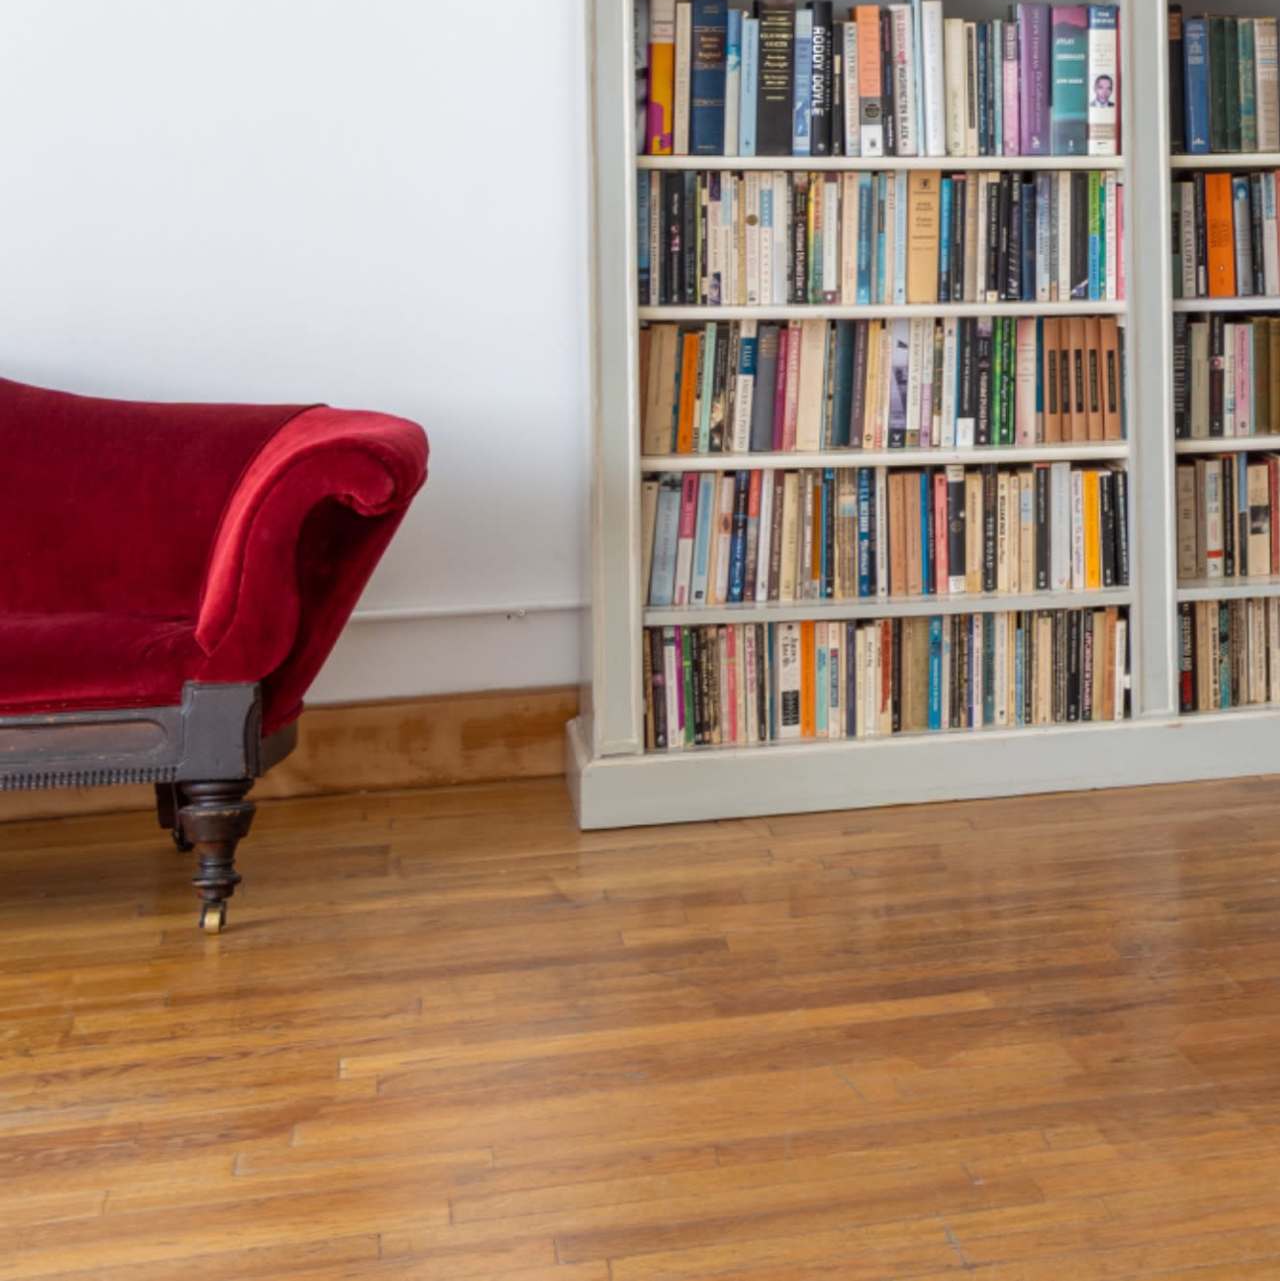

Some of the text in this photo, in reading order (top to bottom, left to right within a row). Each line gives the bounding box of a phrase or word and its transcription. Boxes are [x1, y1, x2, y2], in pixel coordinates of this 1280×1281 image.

[811, 26, 825, 118] RODDY DOYLE
[986, 517, 994, 569] THE ROAD
